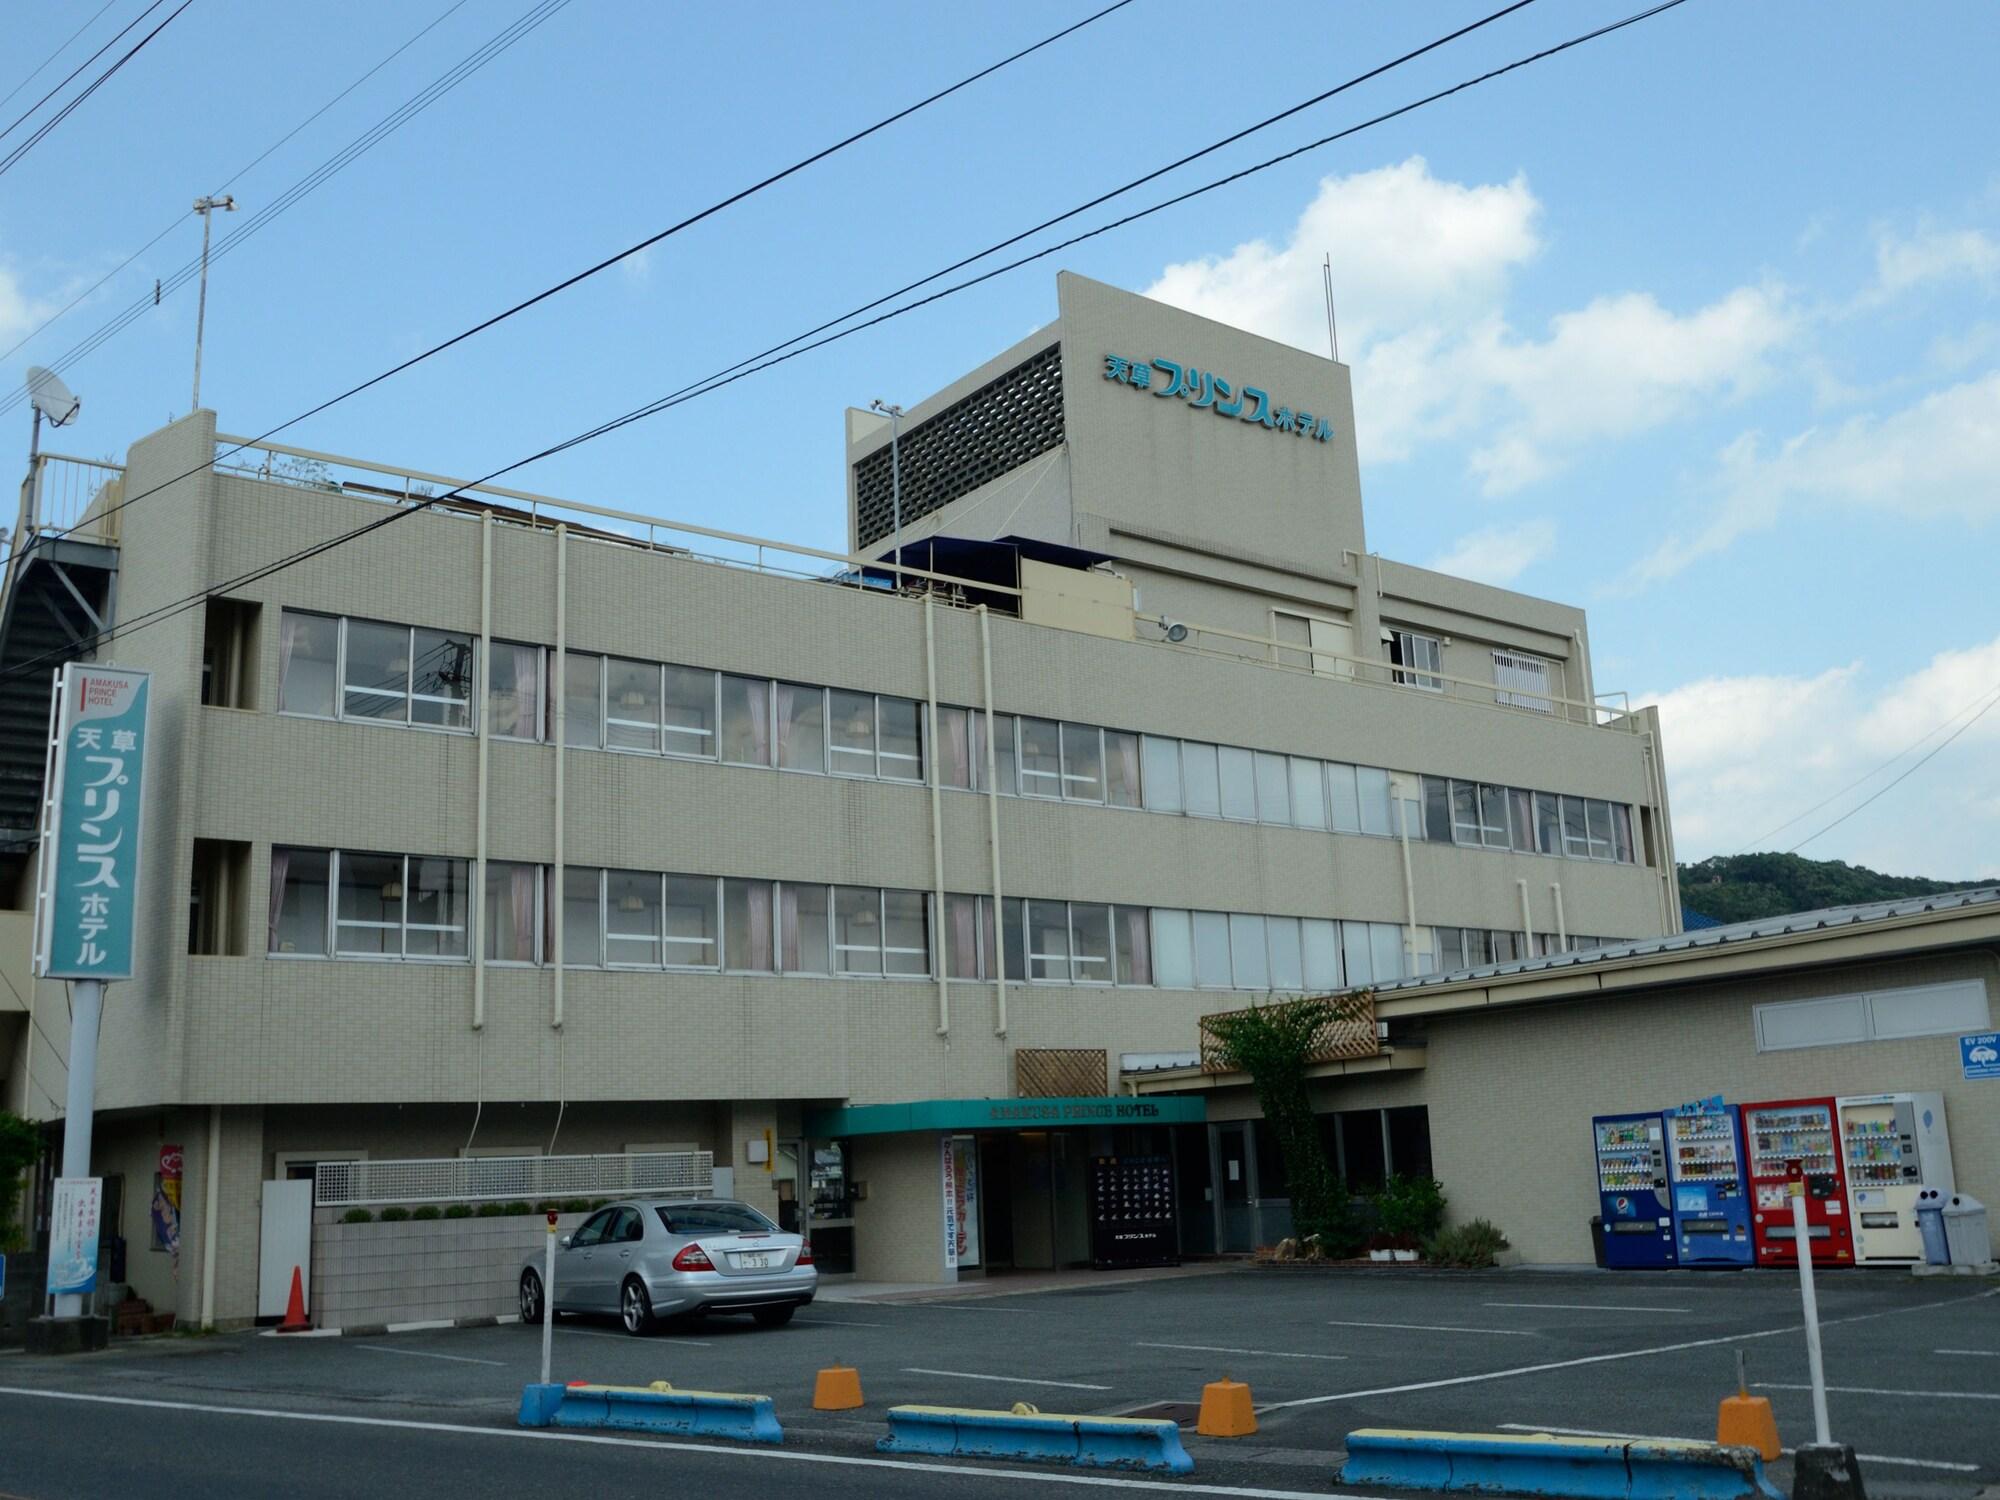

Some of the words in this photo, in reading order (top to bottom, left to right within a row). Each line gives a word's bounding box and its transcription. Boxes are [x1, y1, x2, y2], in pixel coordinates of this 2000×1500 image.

[1103, 353, 1335, 443] 天草プリンスホテル
[90, 678, 129, 689] AMAKUSA
[88, 687, 117, 697] PRINCE
[88, 697, 114, 706] HOTEL
[1964, 1037, 1976, 1046] EV
[1977, 1035, 1997, 1045] 200V
[1117, 1102, 1160, 1118] HOTEL
